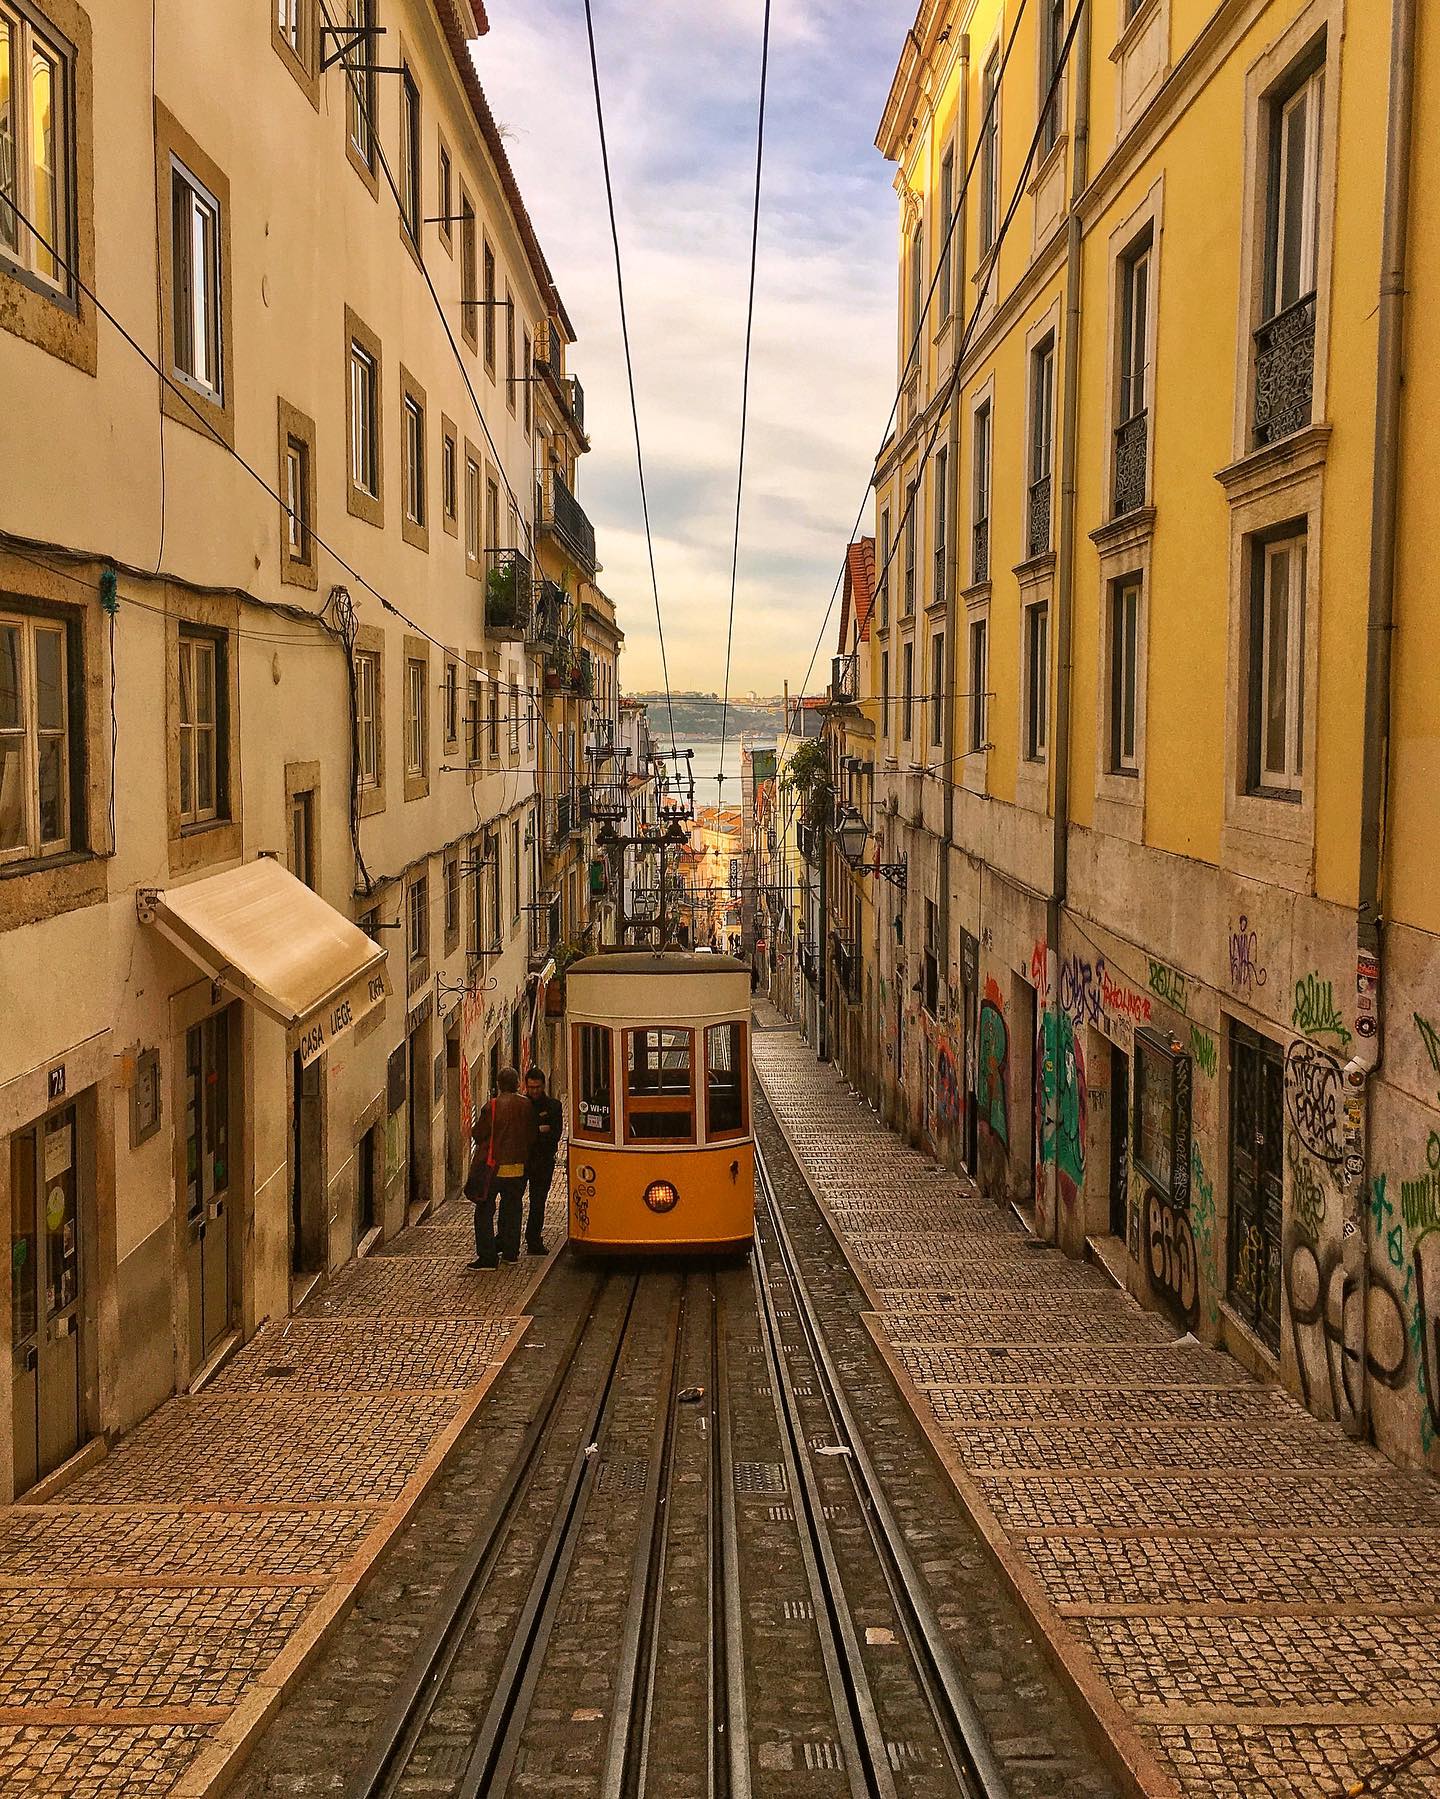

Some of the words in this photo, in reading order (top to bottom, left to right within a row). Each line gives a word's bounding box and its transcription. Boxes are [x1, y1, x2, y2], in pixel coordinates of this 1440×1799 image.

[301, 1023, 325, 1061] CASA
[330, 1000, 353, 1035] LIEGE
[590, 1104, 609, 1114] WI-FI
